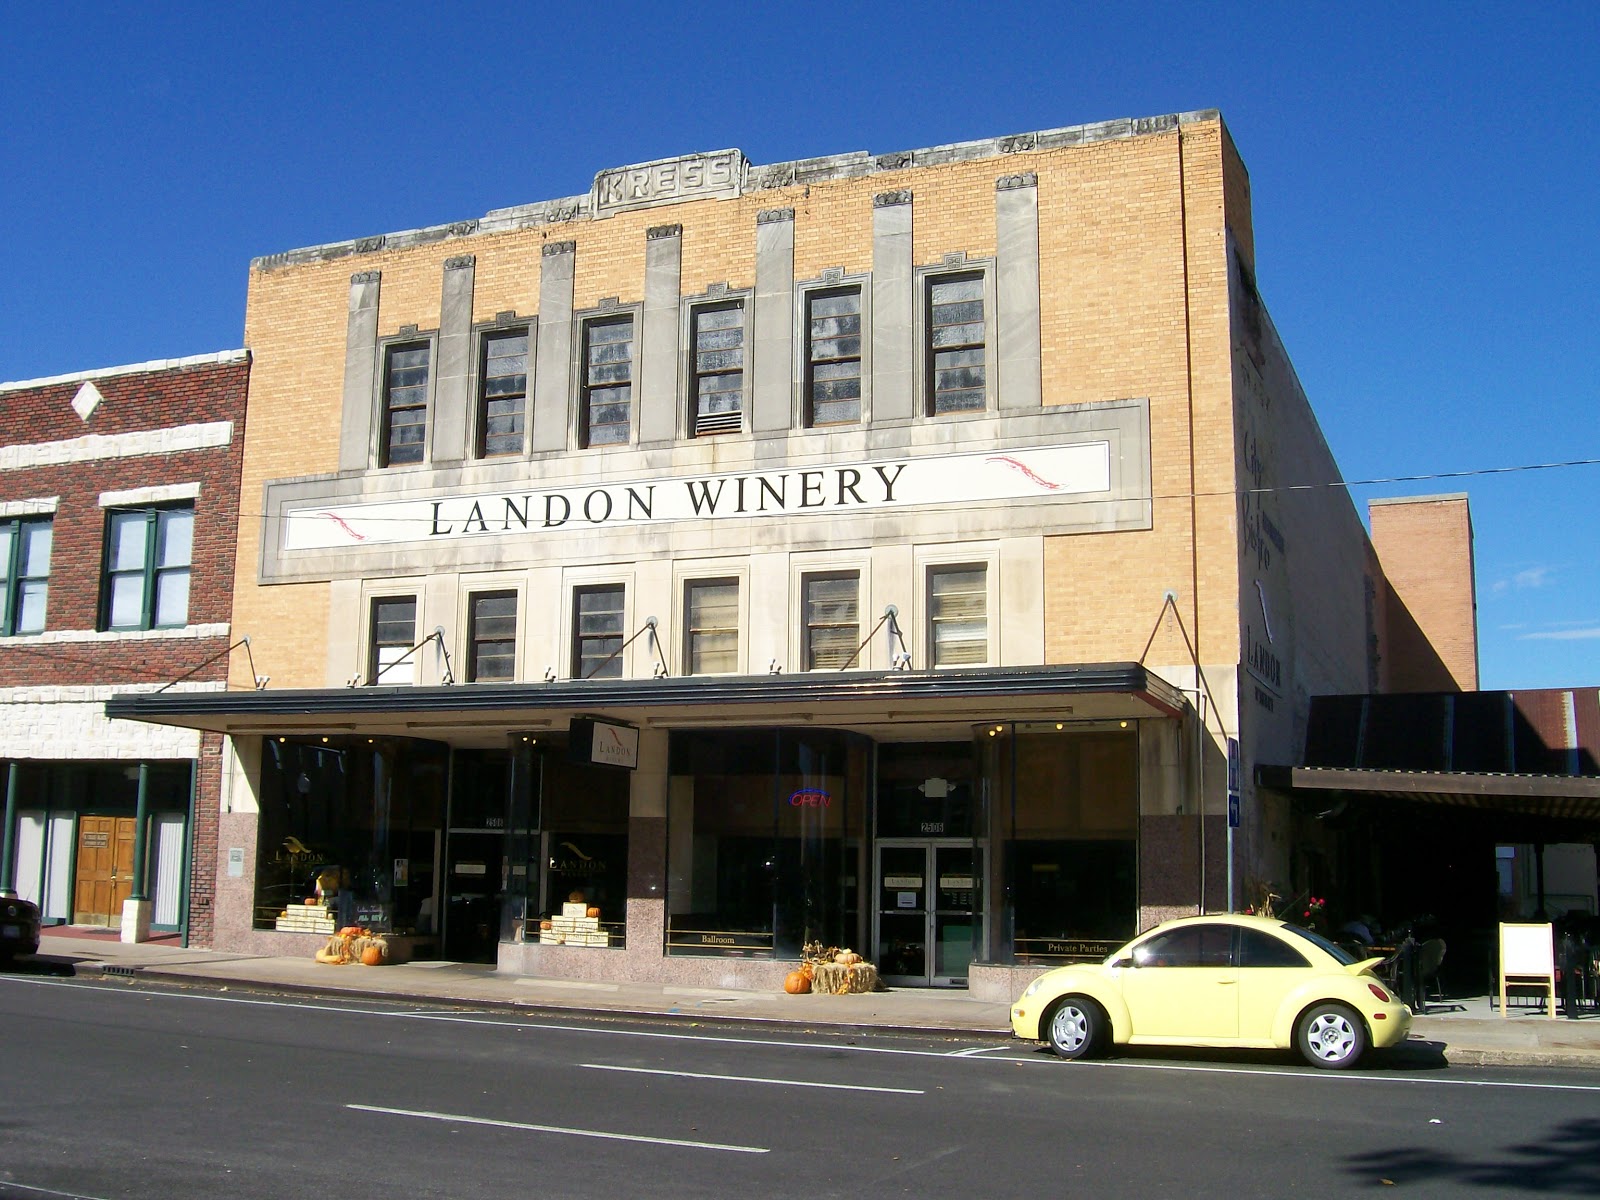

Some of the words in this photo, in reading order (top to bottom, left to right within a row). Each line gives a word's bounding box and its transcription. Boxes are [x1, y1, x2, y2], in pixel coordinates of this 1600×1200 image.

[600, 158, 732, 205] KRESS
[428, 485, 657, 536] LANDON
[684, 464, 908, 517] WINERY
[1247, 624, 1281, 688] LANDON
[599, 741, 631, 756] LANDON
[791, 794, 832, 808] OPEN
[549, 857, 606, 870] LANDON
[702, 934, 735, 944] Ballroom
[1048, 943, 1077, 952] Private
[1079, 944, 1108, 953] Parties
